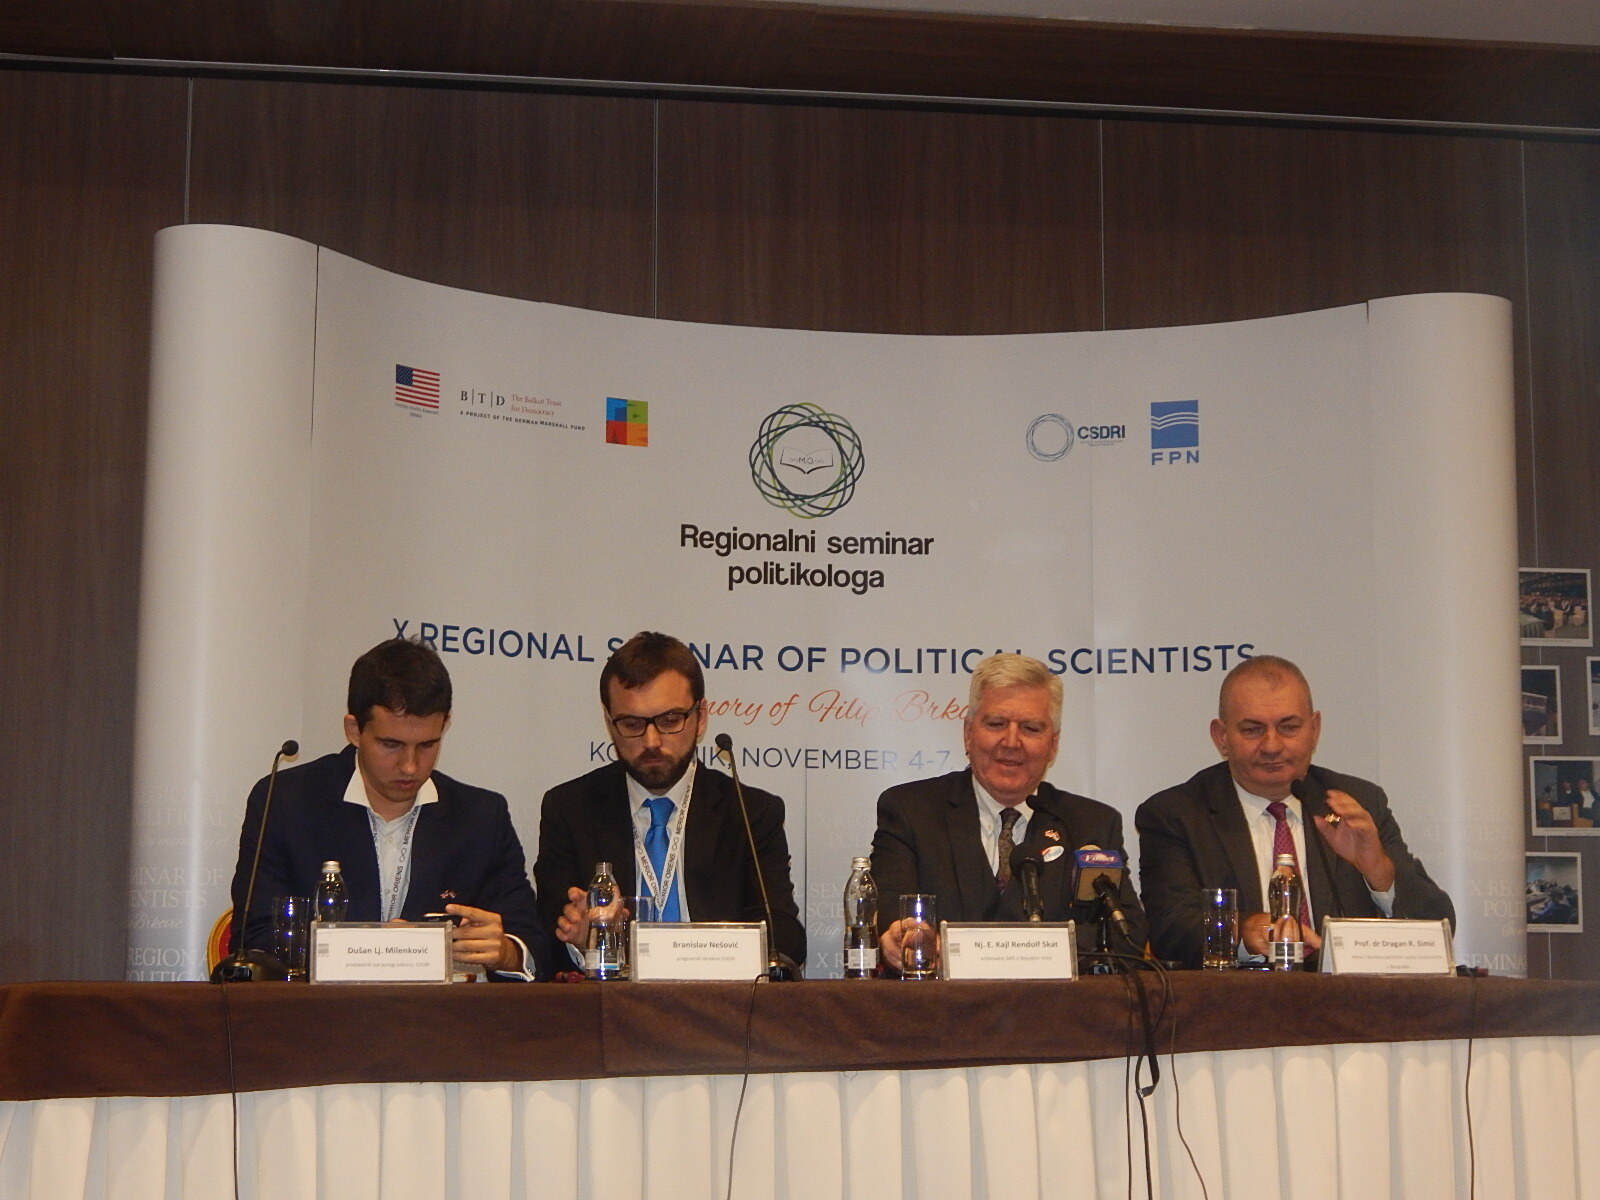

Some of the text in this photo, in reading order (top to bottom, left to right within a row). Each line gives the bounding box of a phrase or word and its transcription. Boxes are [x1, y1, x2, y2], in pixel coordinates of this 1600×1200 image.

[511, 394, 523, 403] The
[465, 411, 491, 419] PROJECT
[514, 417, 538, 425] GERMAN
[1077, 425, 1125, 440] CSDRI
[1151, 450, 1200, 466] FPN
[680, 523, 934, 557] Regionalni seminar
[728, 560, 885, 596] politikologa
[420, 622, 595, 662] REGIONAL
[777, 644, 826, 673] OF
[840, 647, 1022, 675] POLITIC
[768, 693, 800, 726] of
[742, 747, 898, 770] NOVEMBER
[385, 946, 429, 954] Milenković
[672, 941, 708, 949] Branislav
[995, 941, 1010, 949] Kajl
[1382, 940, 1408, 948] Dragan
